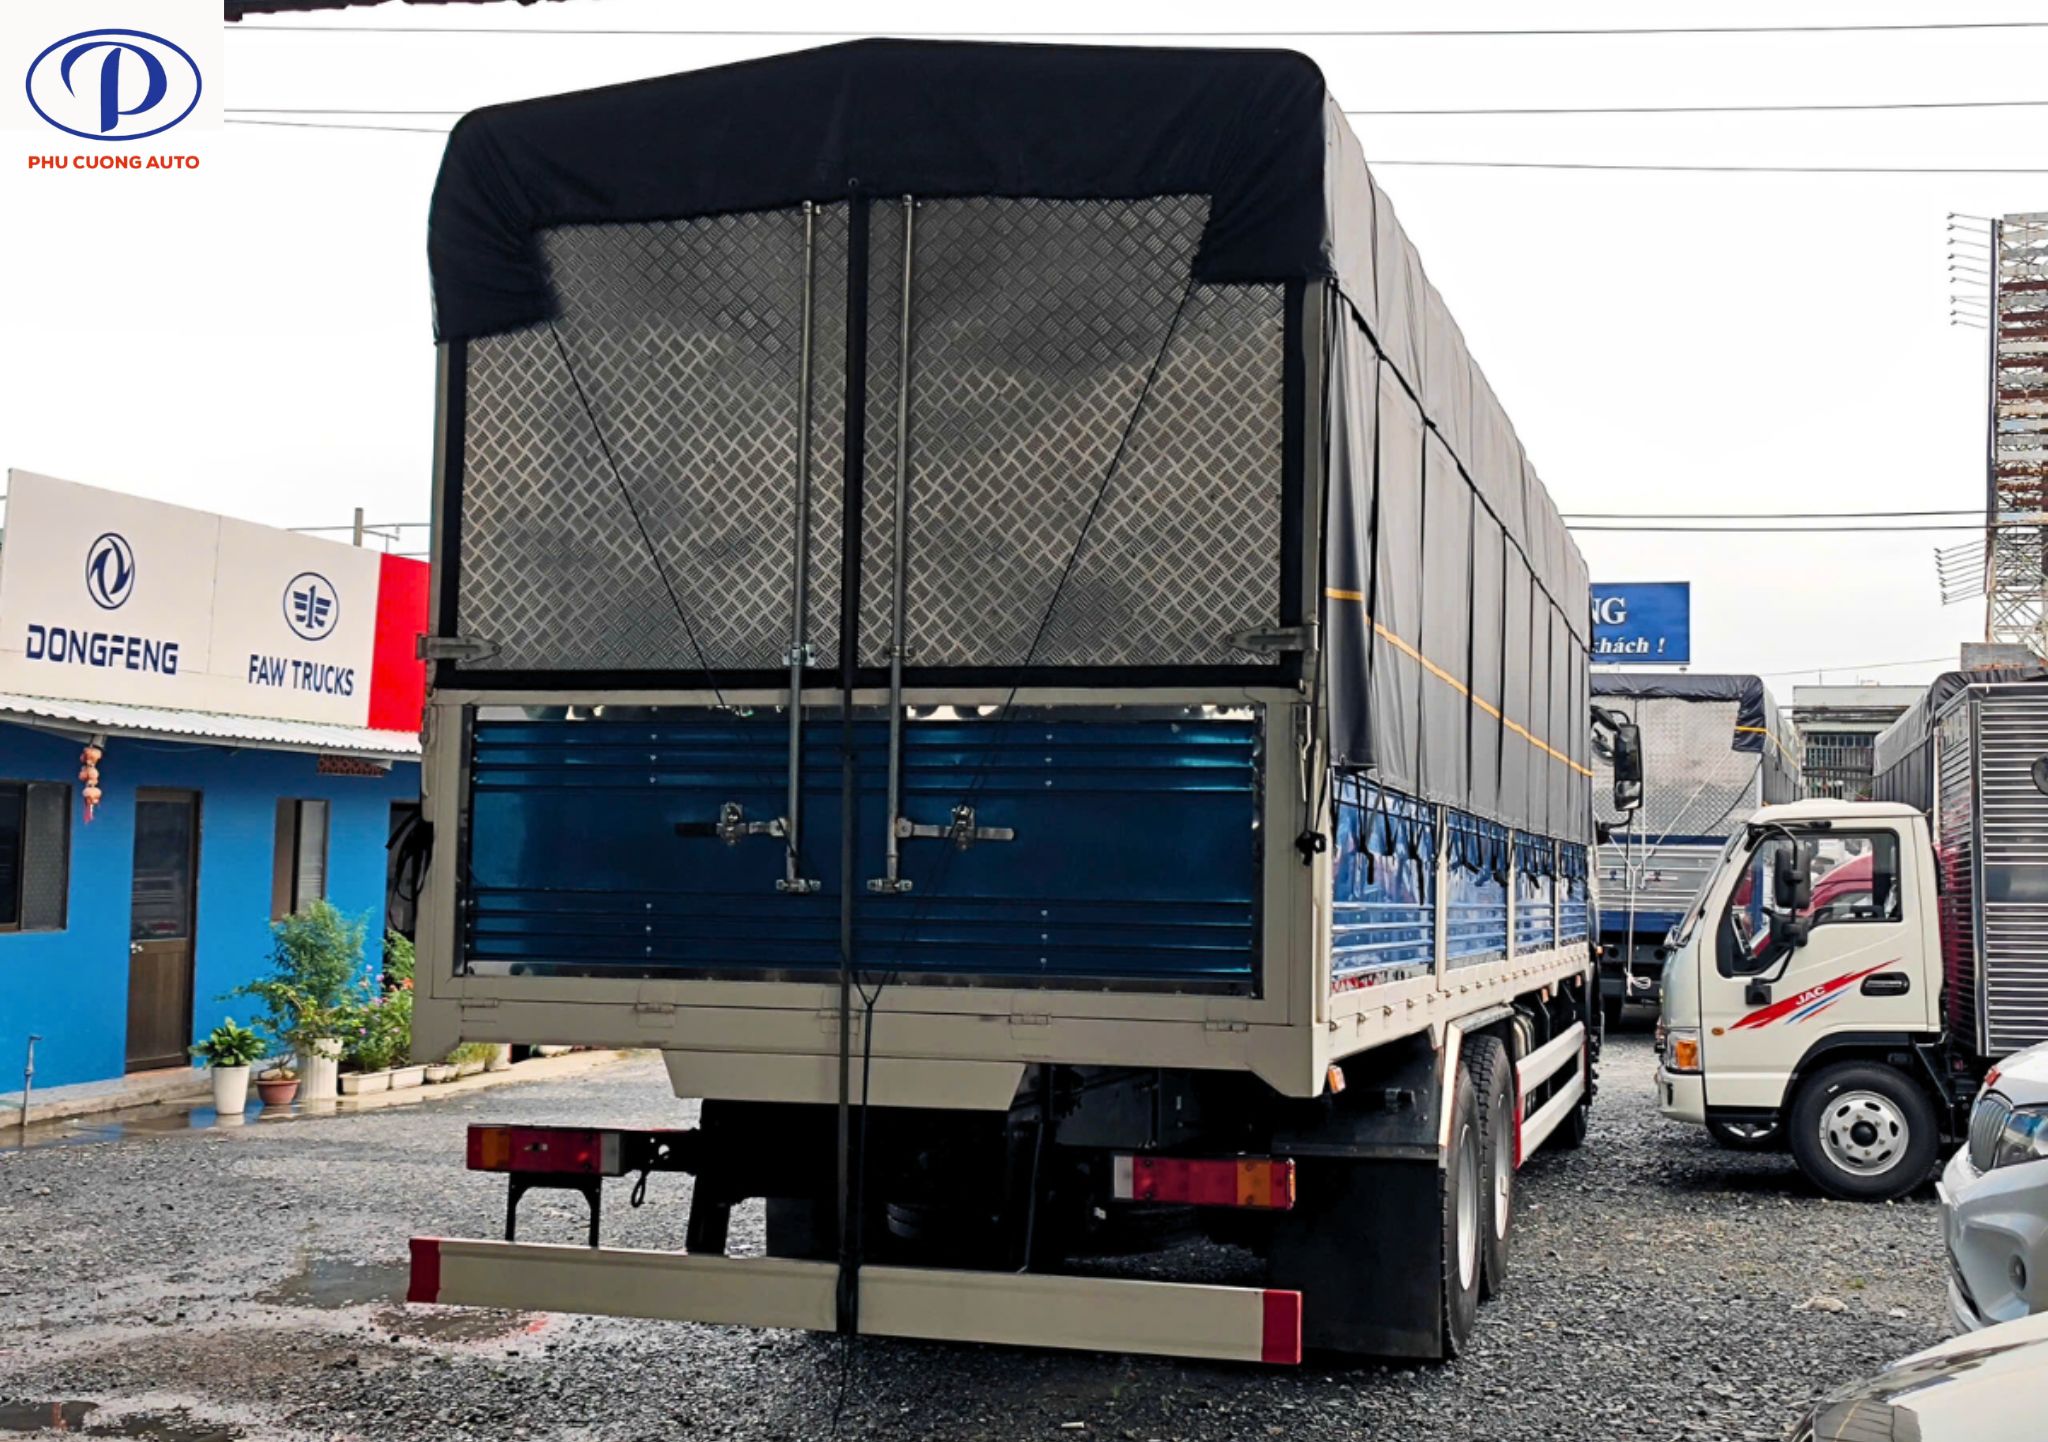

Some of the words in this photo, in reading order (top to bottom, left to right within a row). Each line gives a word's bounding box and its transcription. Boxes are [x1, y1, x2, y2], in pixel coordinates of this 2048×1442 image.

[26, 624, 179, 675] DONGFENG
[248, 654, 287, 687] FAW
[292, 660, 354, 697] TRUCKS
[1796, 986, 1826, 1005] JAC
